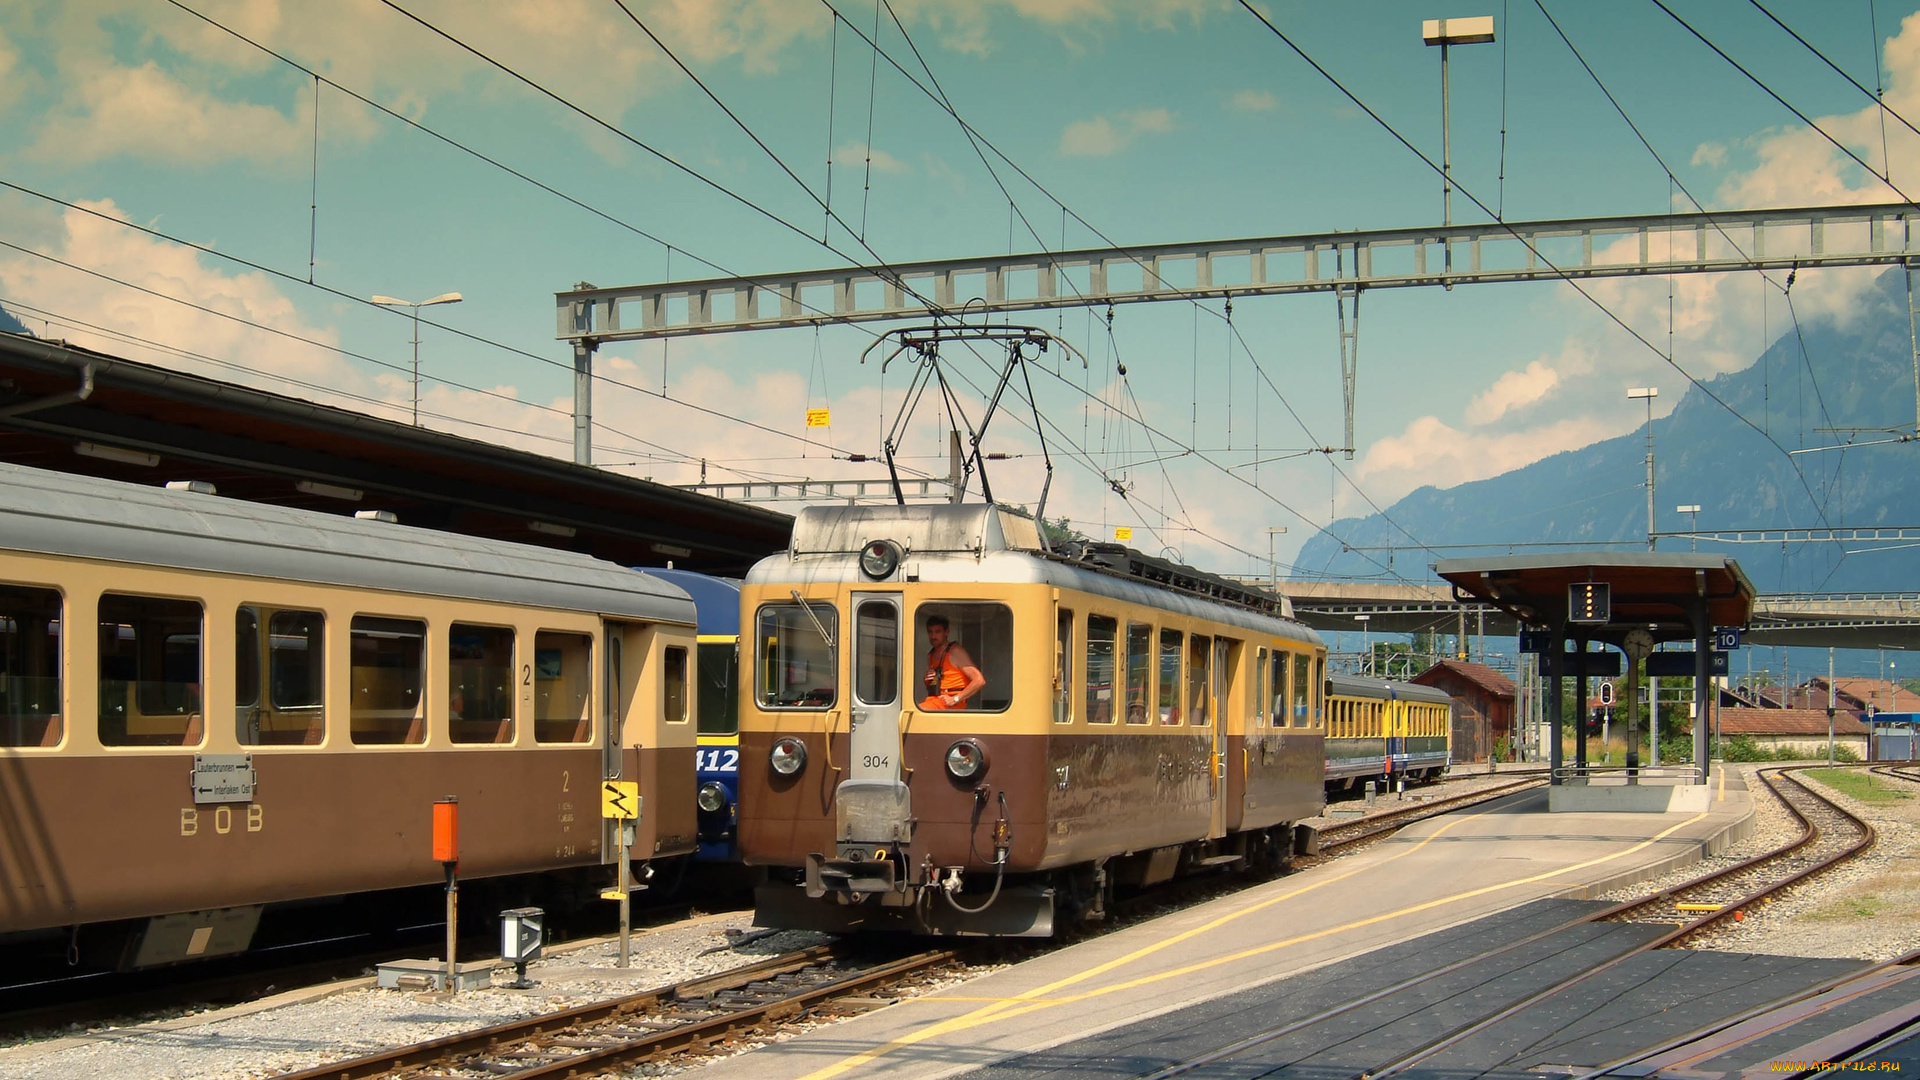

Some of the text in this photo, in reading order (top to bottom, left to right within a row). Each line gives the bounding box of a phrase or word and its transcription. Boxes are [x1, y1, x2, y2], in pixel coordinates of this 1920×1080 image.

[1720, 634, 1736, 646] 10
[523, 664, 531, 686] 2
[863, 755, 889, 768] 304
[197, 763, 235, 773] Lauterbrunnen
[562, 770, 570, 793] 2
[214, 784, 251, 795] Interlaken Ost
